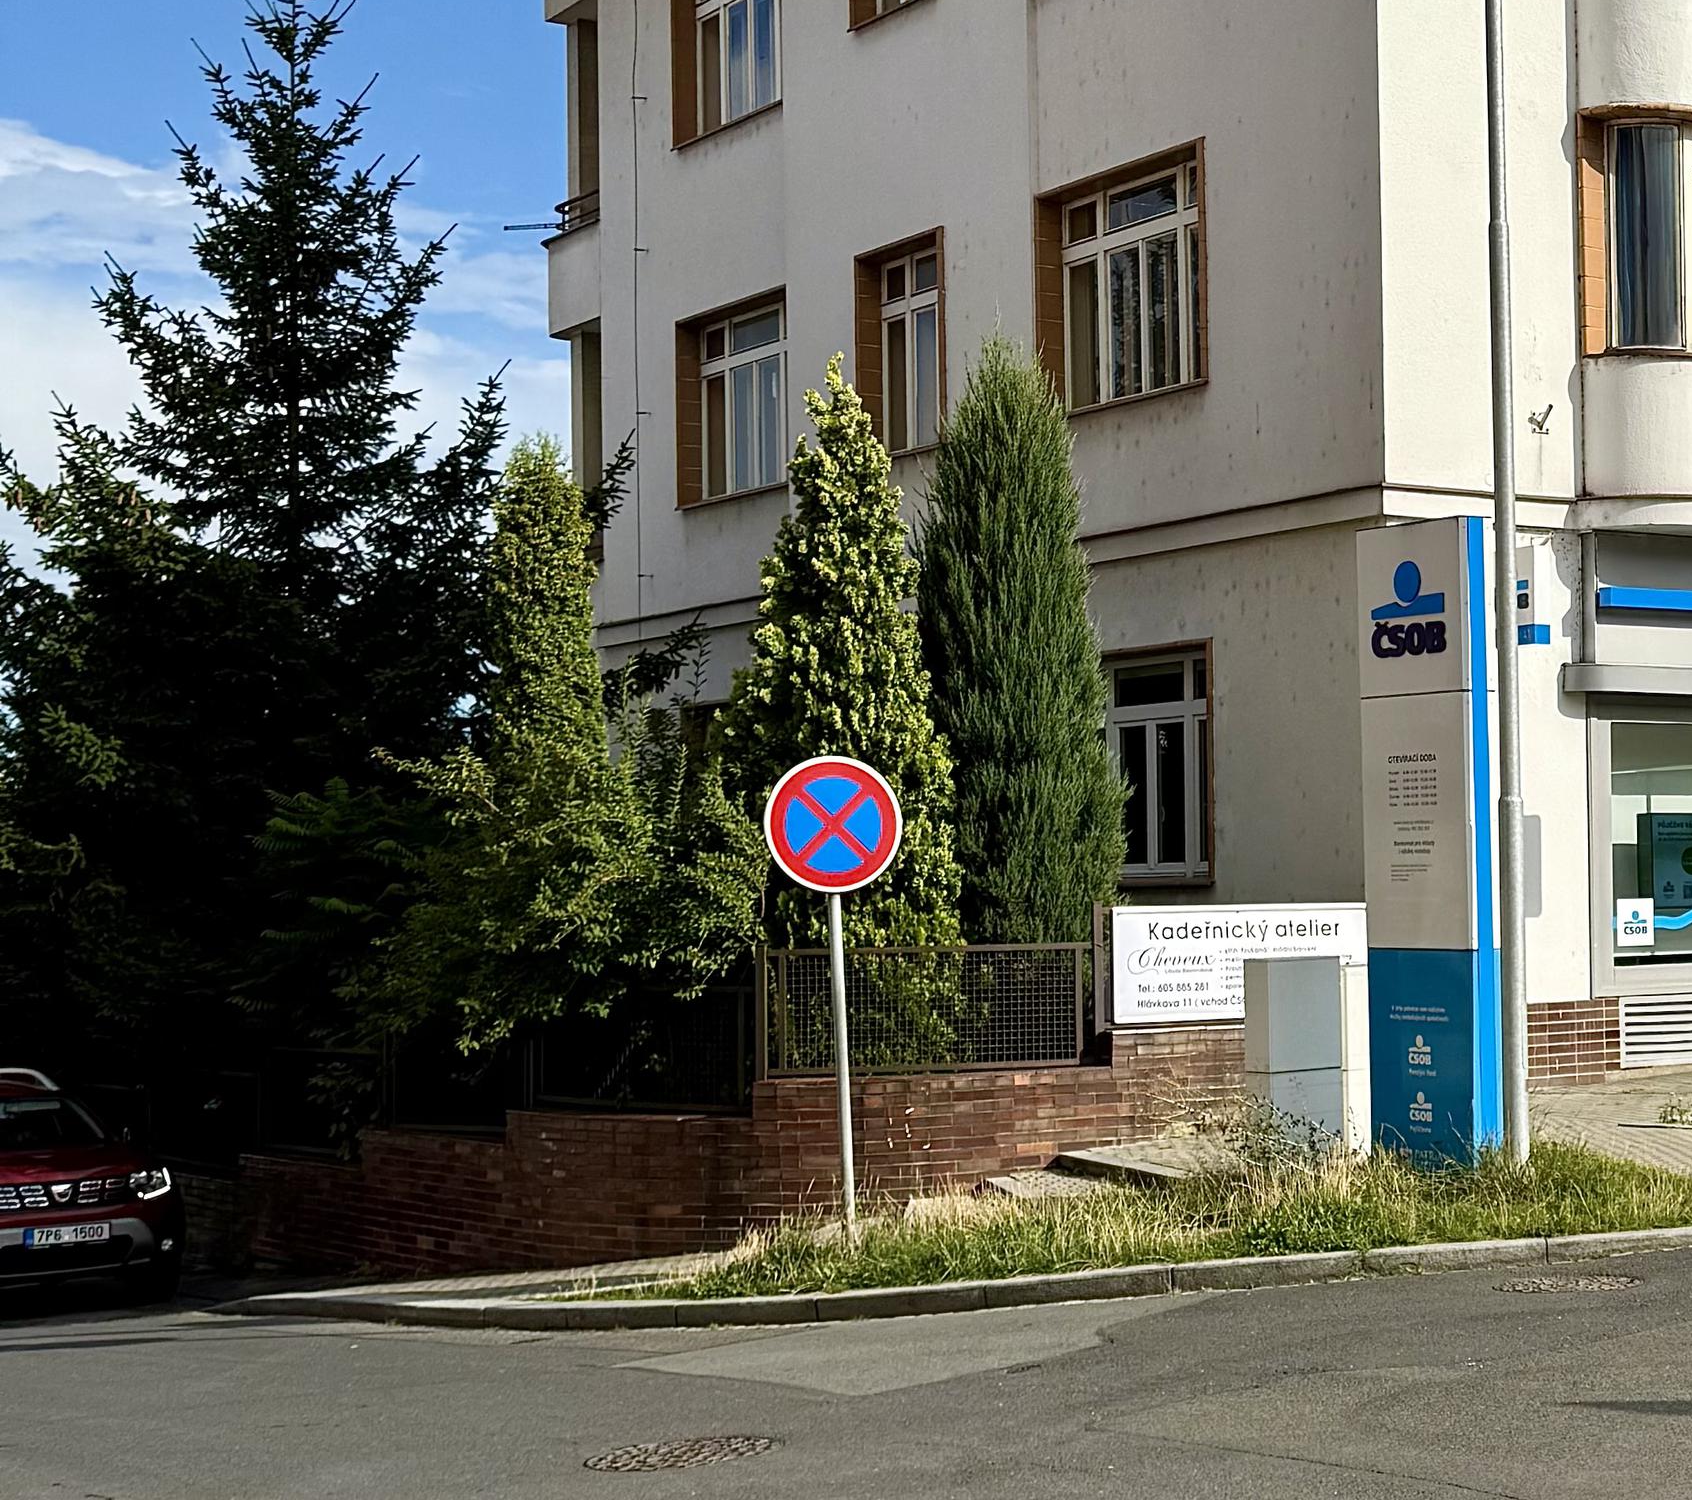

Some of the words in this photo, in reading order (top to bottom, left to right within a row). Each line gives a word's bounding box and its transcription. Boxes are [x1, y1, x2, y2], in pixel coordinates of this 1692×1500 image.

[1371, 620, 1447, 658] ČSOB
[1148, 919, 1269, 942] Kadeřnický
[1275, 919, 1341, 938] atelier
[1157, 982, 1174, 993] 605
[1137, 998, 1180, 1009] Hlávkova
[37, 1229, 62, 1243] 7P6
[72, 1225, 104, 1239] 1500
